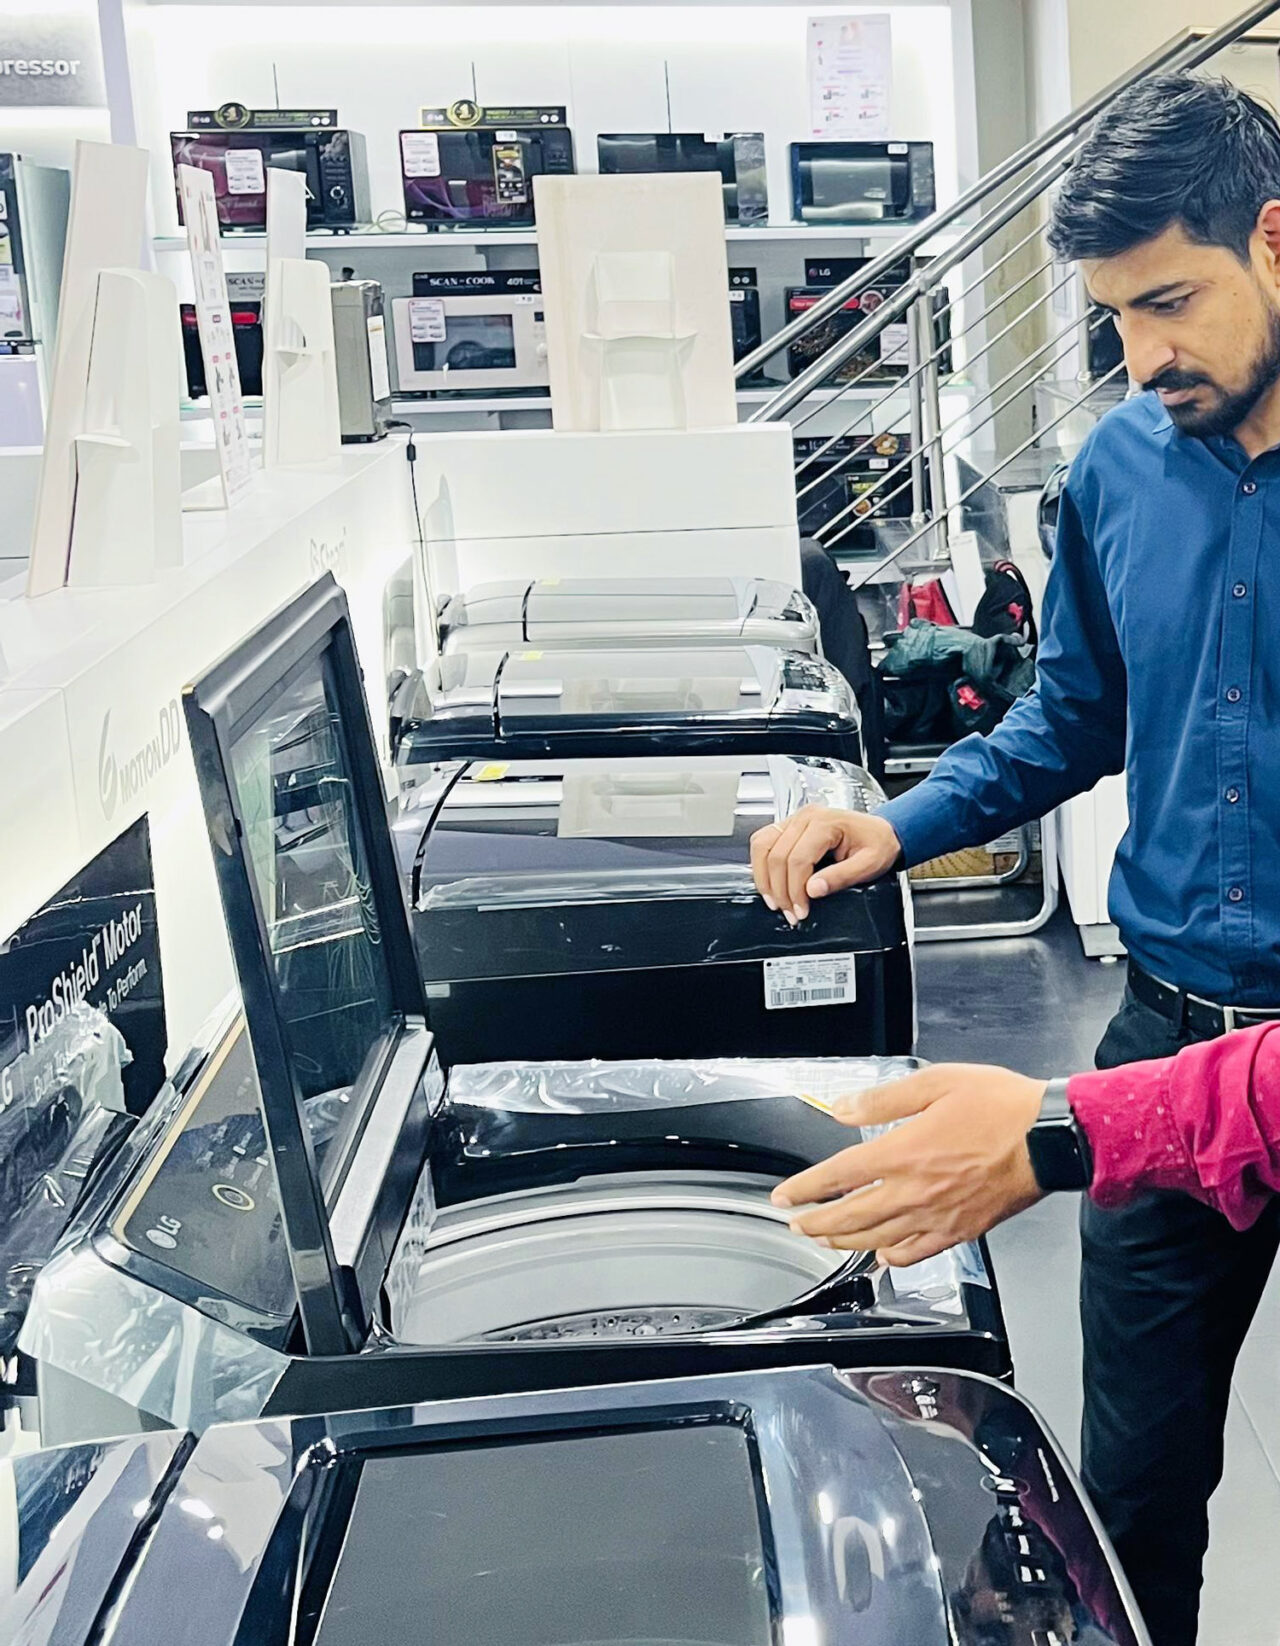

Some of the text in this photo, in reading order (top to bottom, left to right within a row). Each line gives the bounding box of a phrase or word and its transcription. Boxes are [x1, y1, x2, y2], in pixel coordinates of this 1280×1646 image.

[0, 59, 81, 76] ressor
[820, 267, 831, 277] LG
[103, 902, 143, 970] Motor
[0, 1065, 13, 1115] G
[156, 1214, 182, 1236] LG
